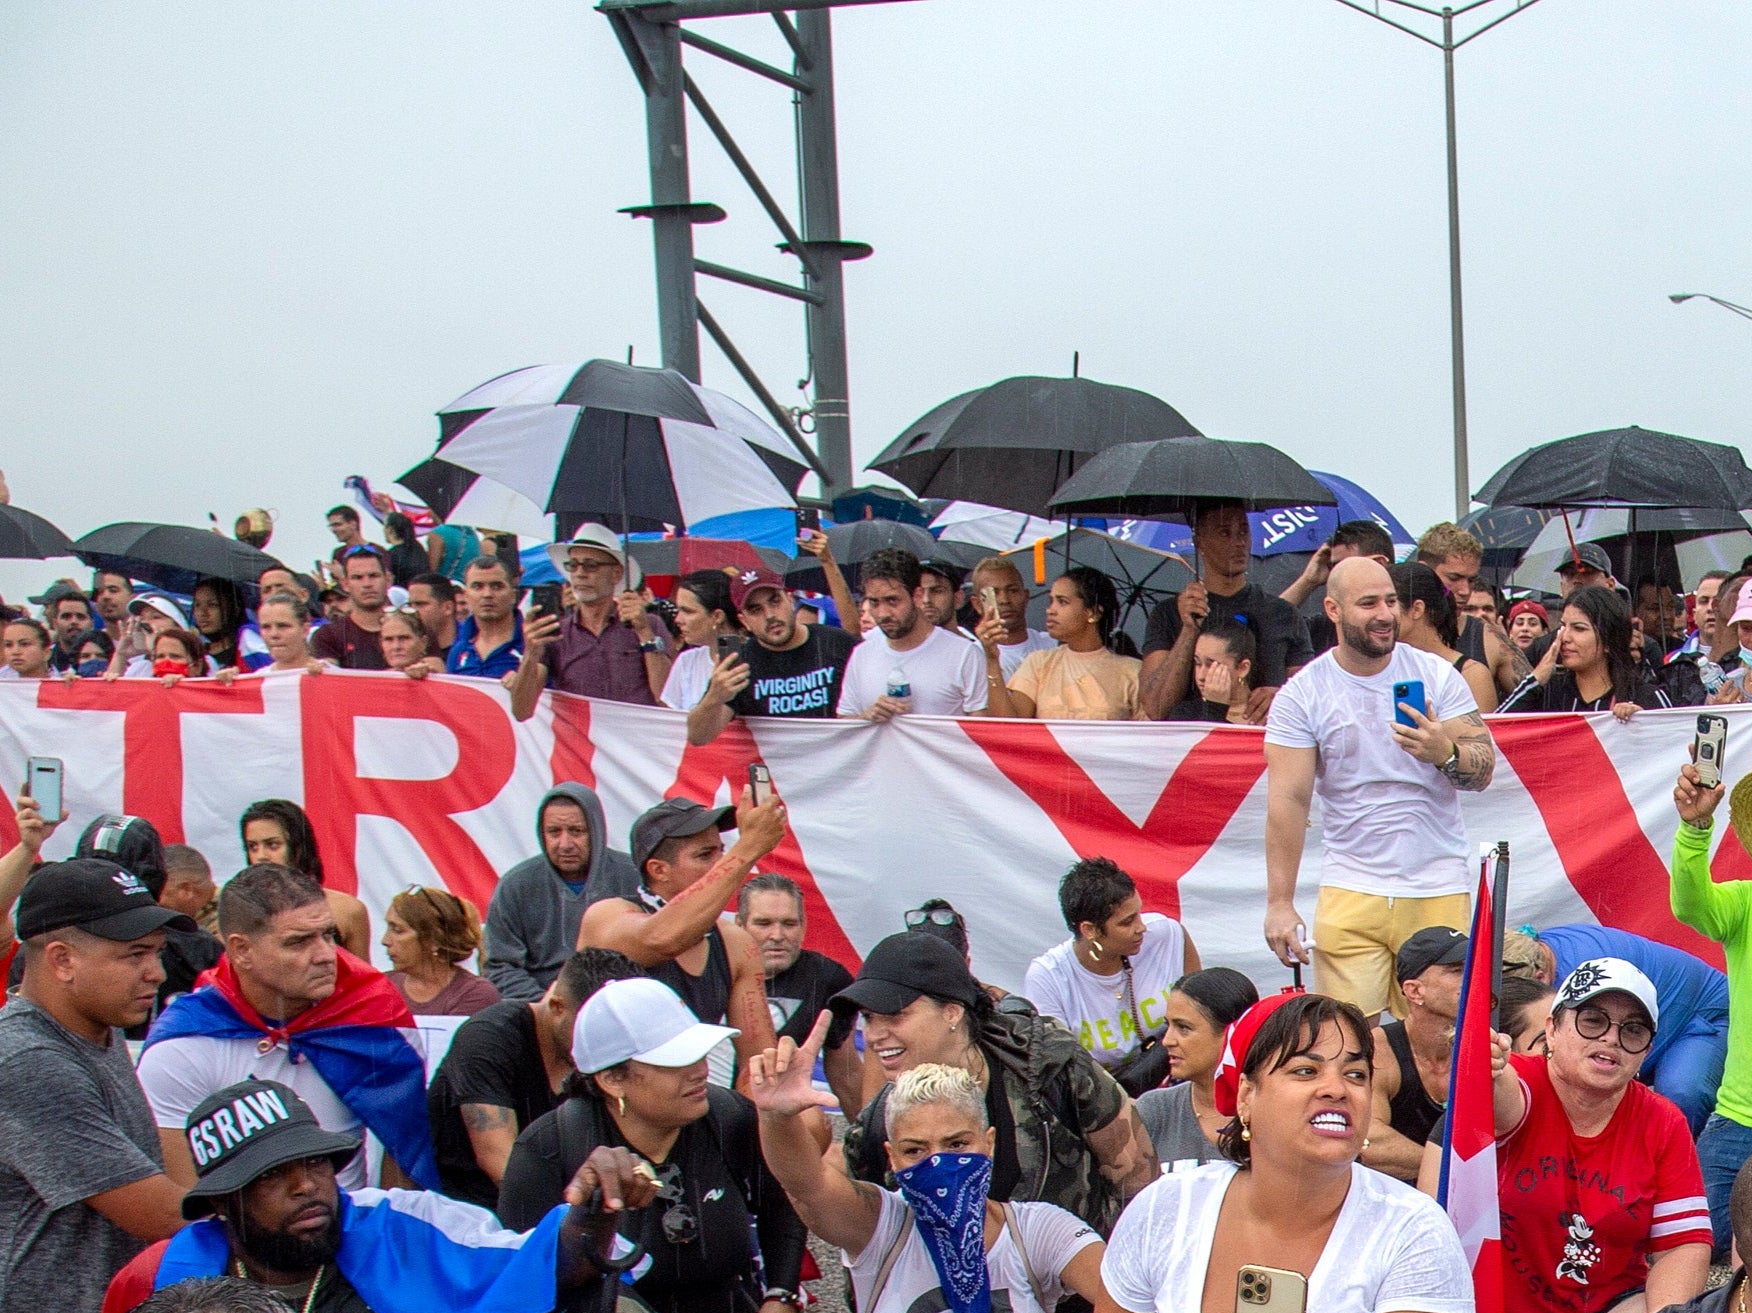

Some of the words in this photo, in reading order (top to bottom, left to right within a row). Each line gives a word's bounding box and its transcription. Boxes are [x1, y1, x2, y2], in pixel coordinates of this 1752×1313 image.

[754, 666, 835, 700] ¡VIRGINITY
[769, 687, 829, 714] ROCAS!
[1078, 982, 1174, 1052] BEAC
